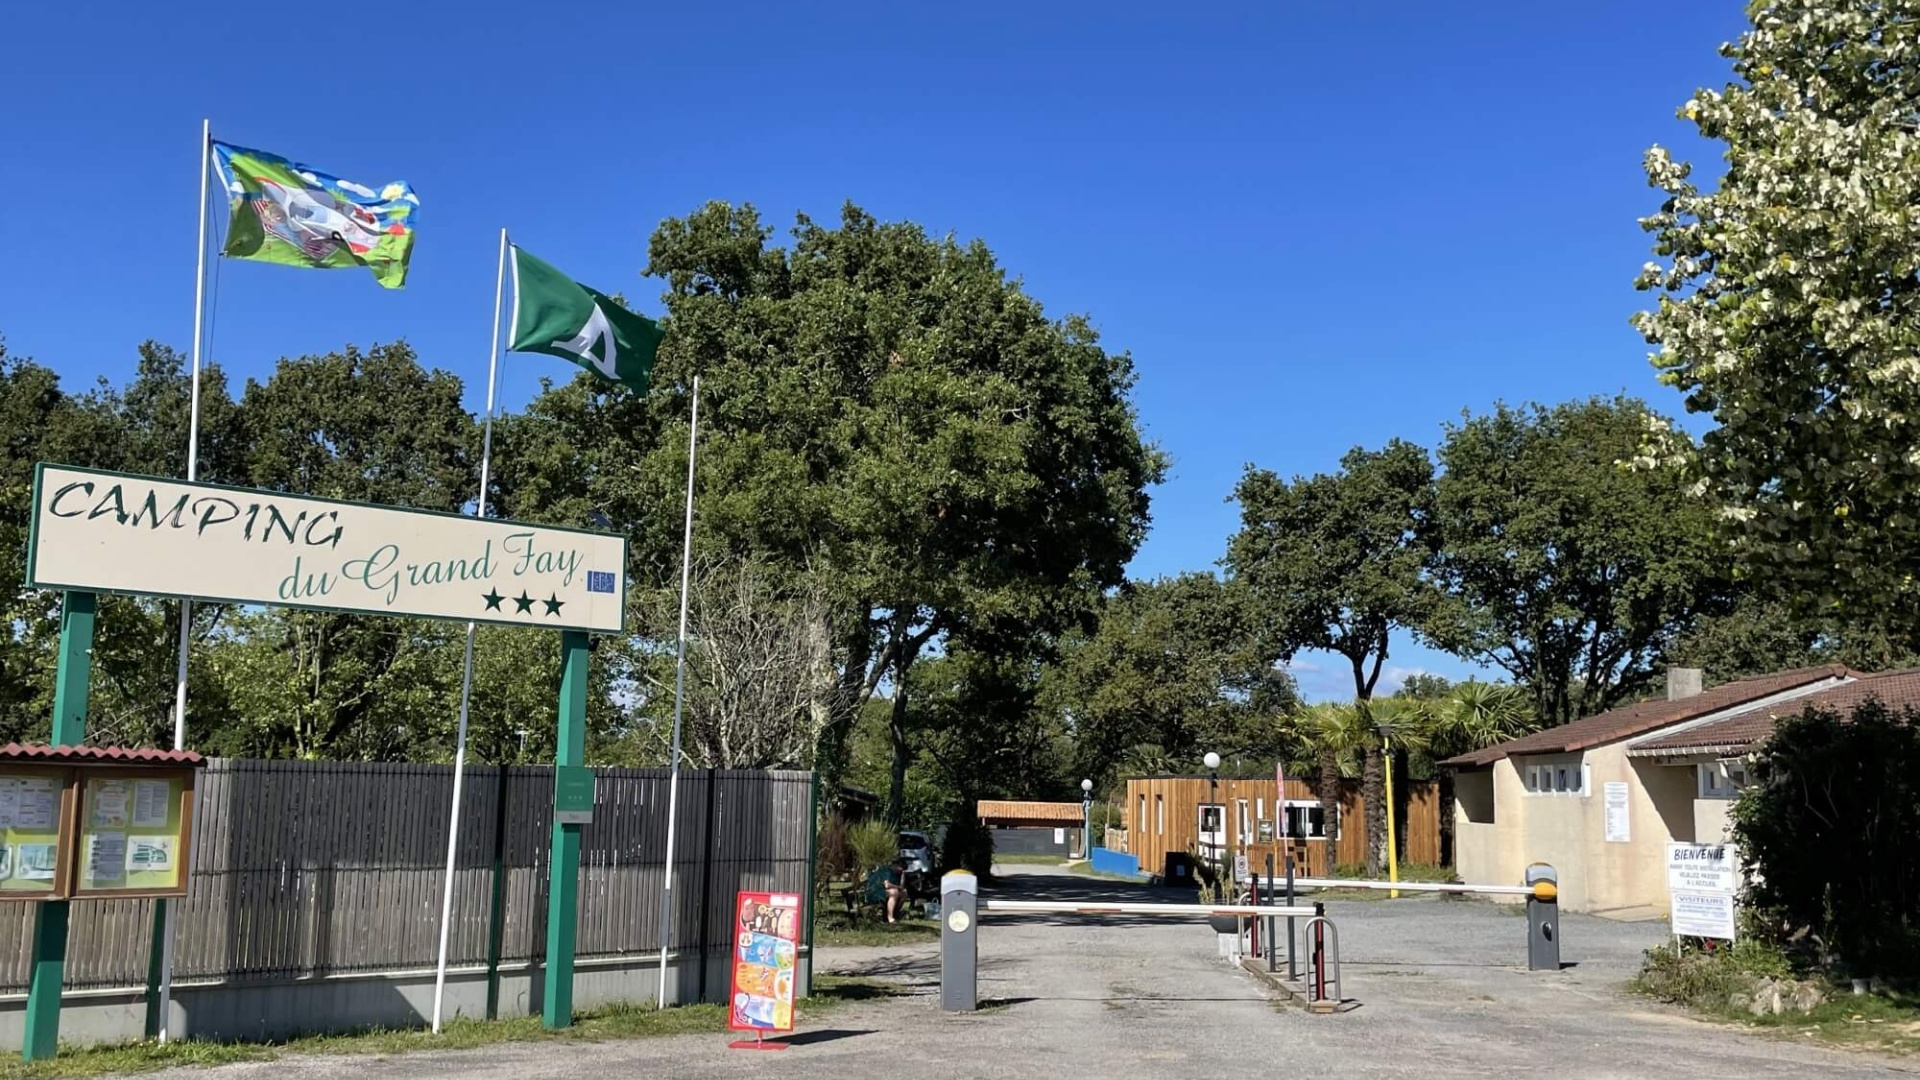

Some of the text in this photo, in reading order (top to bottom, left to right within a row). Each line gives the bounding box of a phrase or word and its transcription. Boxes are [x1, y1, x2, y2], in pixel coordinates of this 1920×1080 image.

[49, 481, 344, 550] CAMPING
[278, 531, 584, 606] du Grand Fay
[1674, 848, 1726, 860] BIENVENUE
[1679, 896, 1724, 904] VISITEURS
